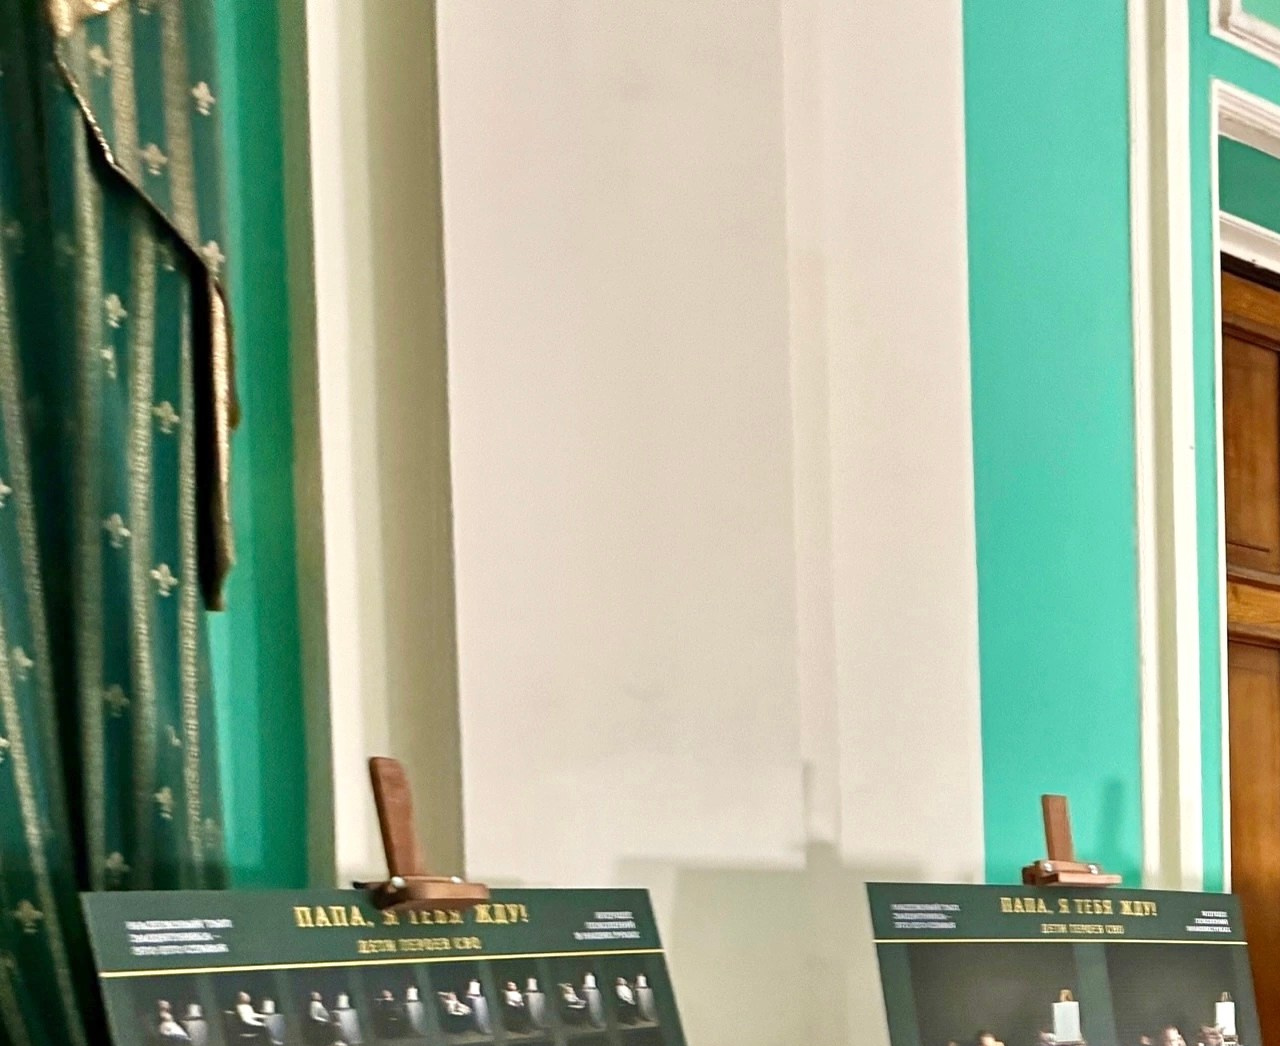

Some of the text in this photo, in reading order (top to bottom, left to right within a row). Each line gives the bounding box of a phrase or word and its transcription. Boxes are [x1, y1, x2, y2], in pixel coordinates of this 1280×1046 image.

[381, 907, 400, 926] Я
[408, 908, 464, 926] ТЕБЯ
[473, 903, 529, 925] ЖДУ!
[1058, 898, 1071, 914] Я
[1073, 898, 1114, 915] ТЕБЯ
